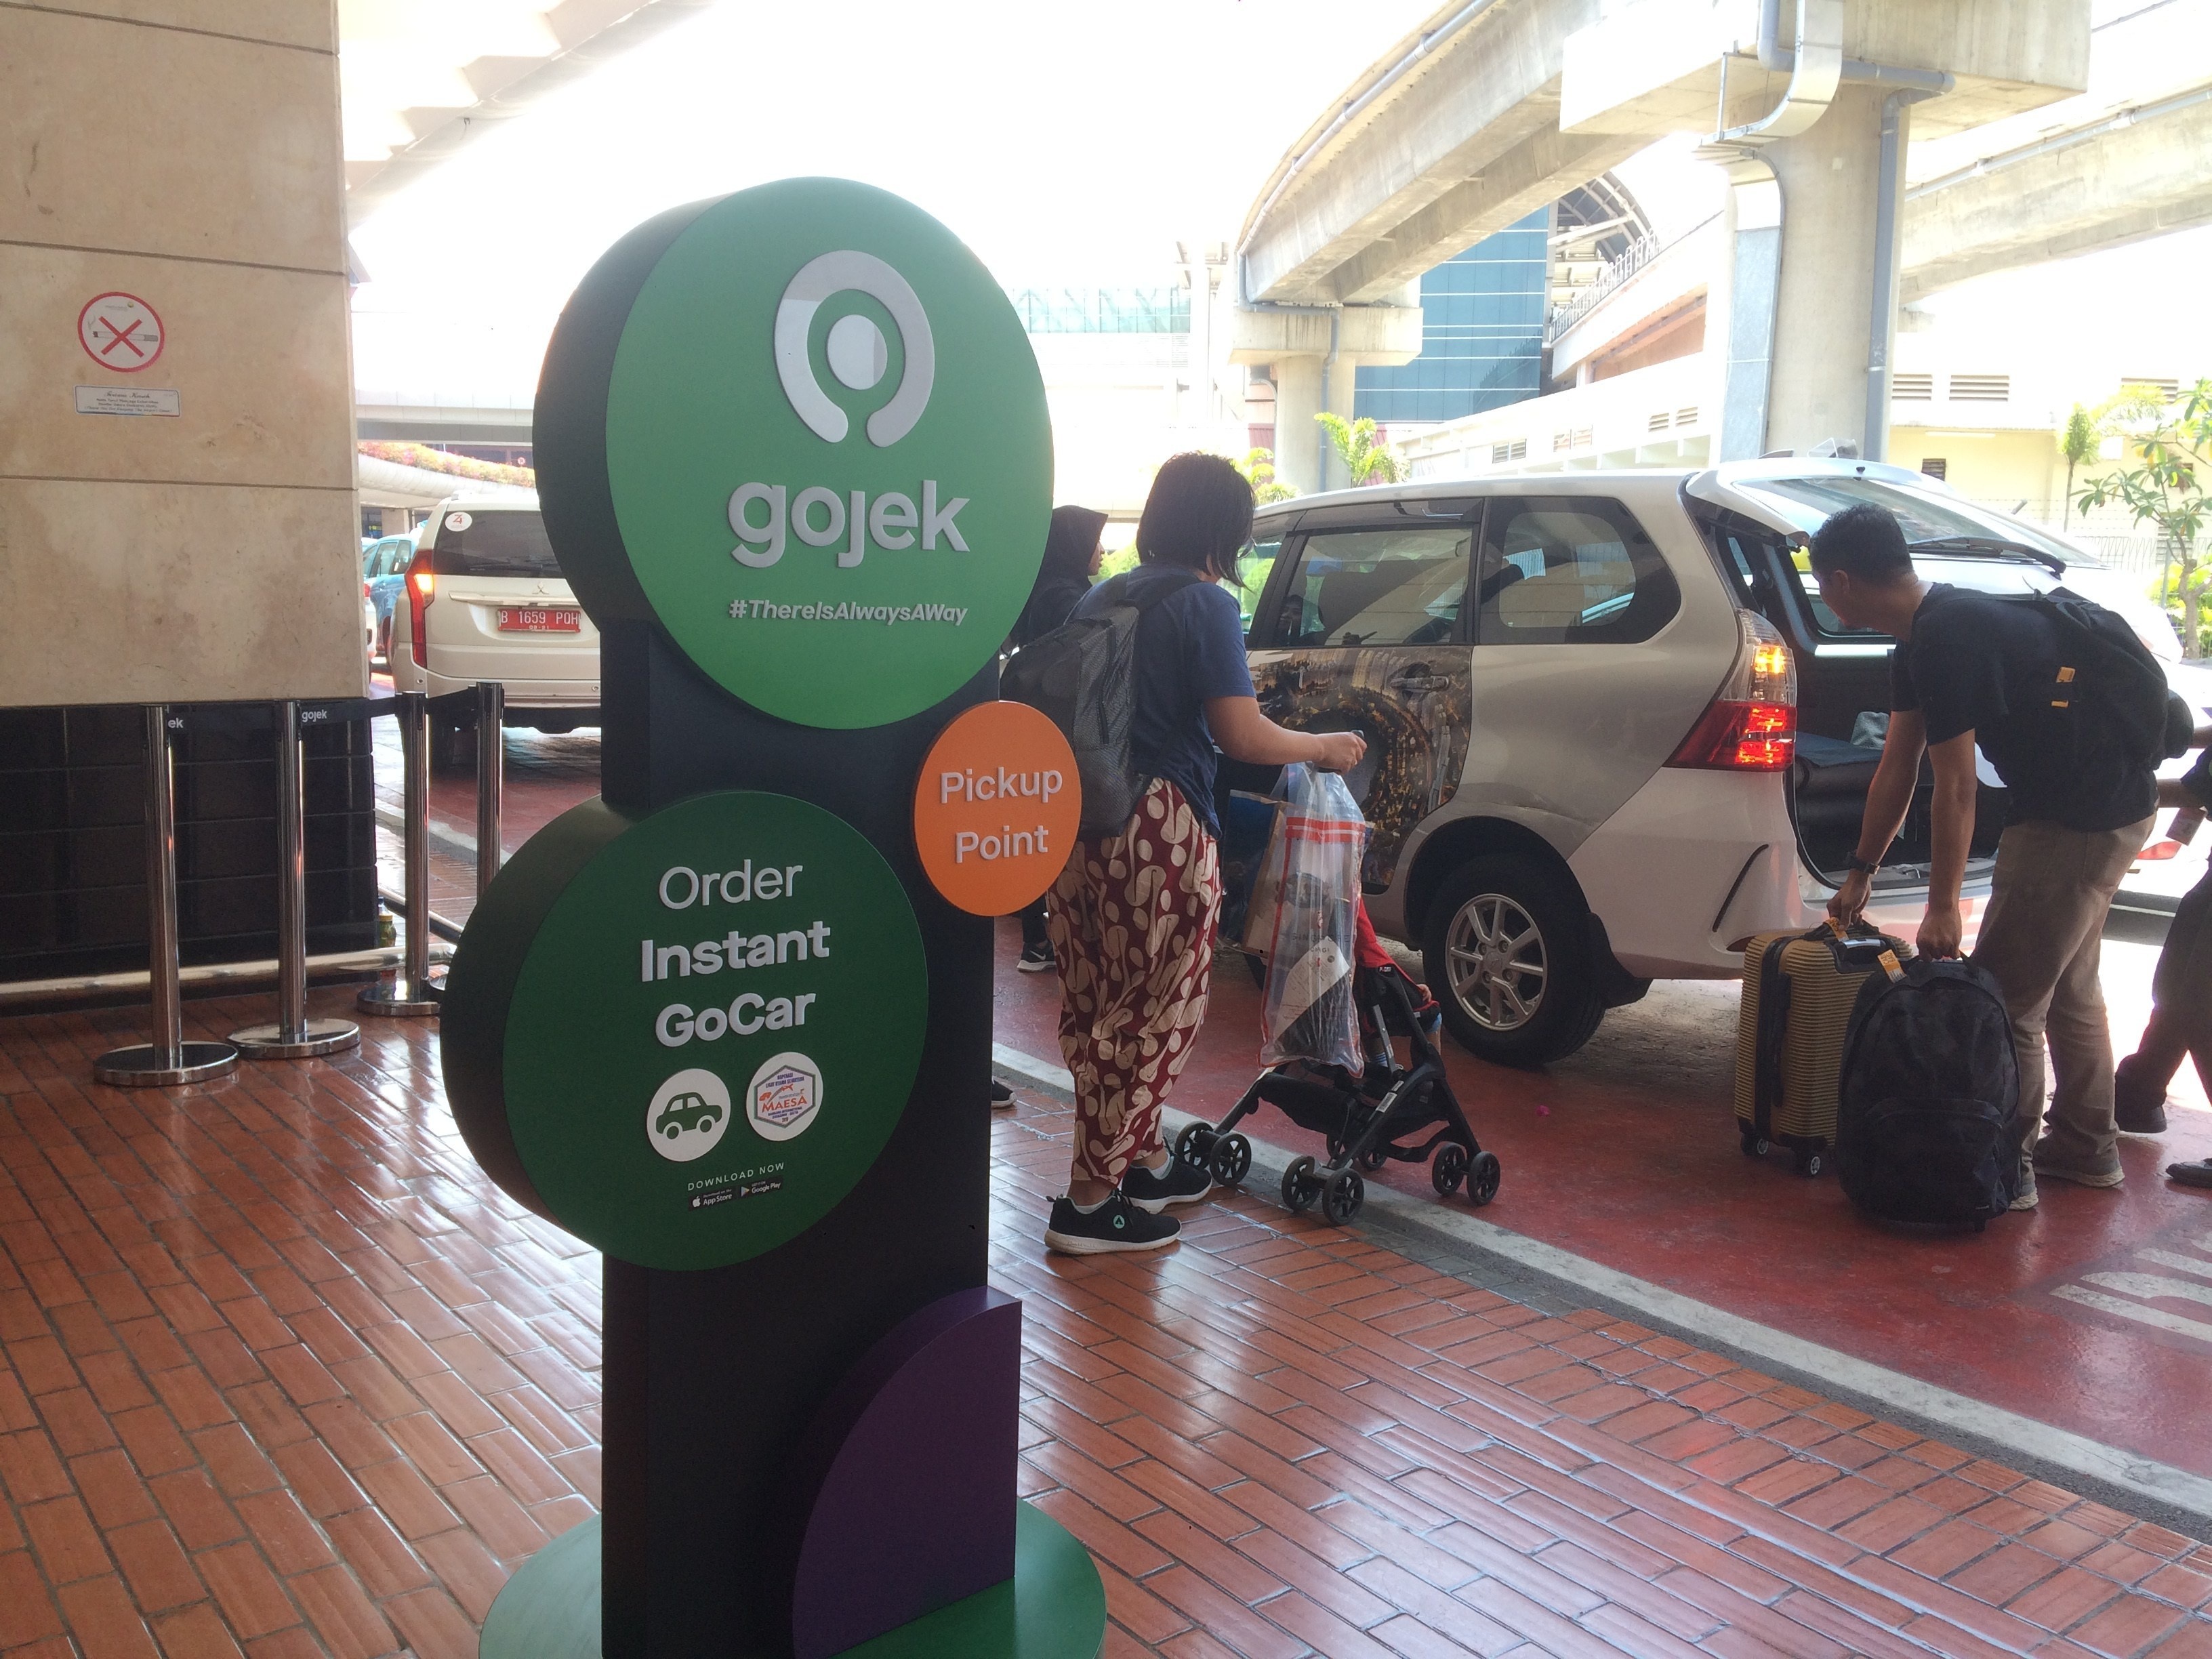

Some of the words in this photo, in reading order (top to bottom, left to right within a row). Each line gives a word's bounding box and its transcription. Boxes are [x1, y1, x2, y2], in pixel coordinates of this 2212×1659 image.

[728, 480, 970, 568] gojek
[501, 611, 508, 623] B
[519, 611, 546, 623] 1659
[729, 599, 968, 626] #ThereIsAlwaysAWay
[302, 710, 327, 722] gojek
[941, 766, 1063, 804] Pickup
[956, 825, 1049, 863] Point
[659, 859, 803, 909] Order
[642, 920, 831, 982] Instant
[655, 992, 817, 1047] GoCar
[761, 1095, 808, 1113] MAESA
[688, 1169, 754, 1191] DOWNLOAD
[759, 1162, 784, 1175] NOW
[751, 1185, 770, 1194] Google
[703, 1197, 716, 1206] App
[716, 1193, 733, 1203] Store
